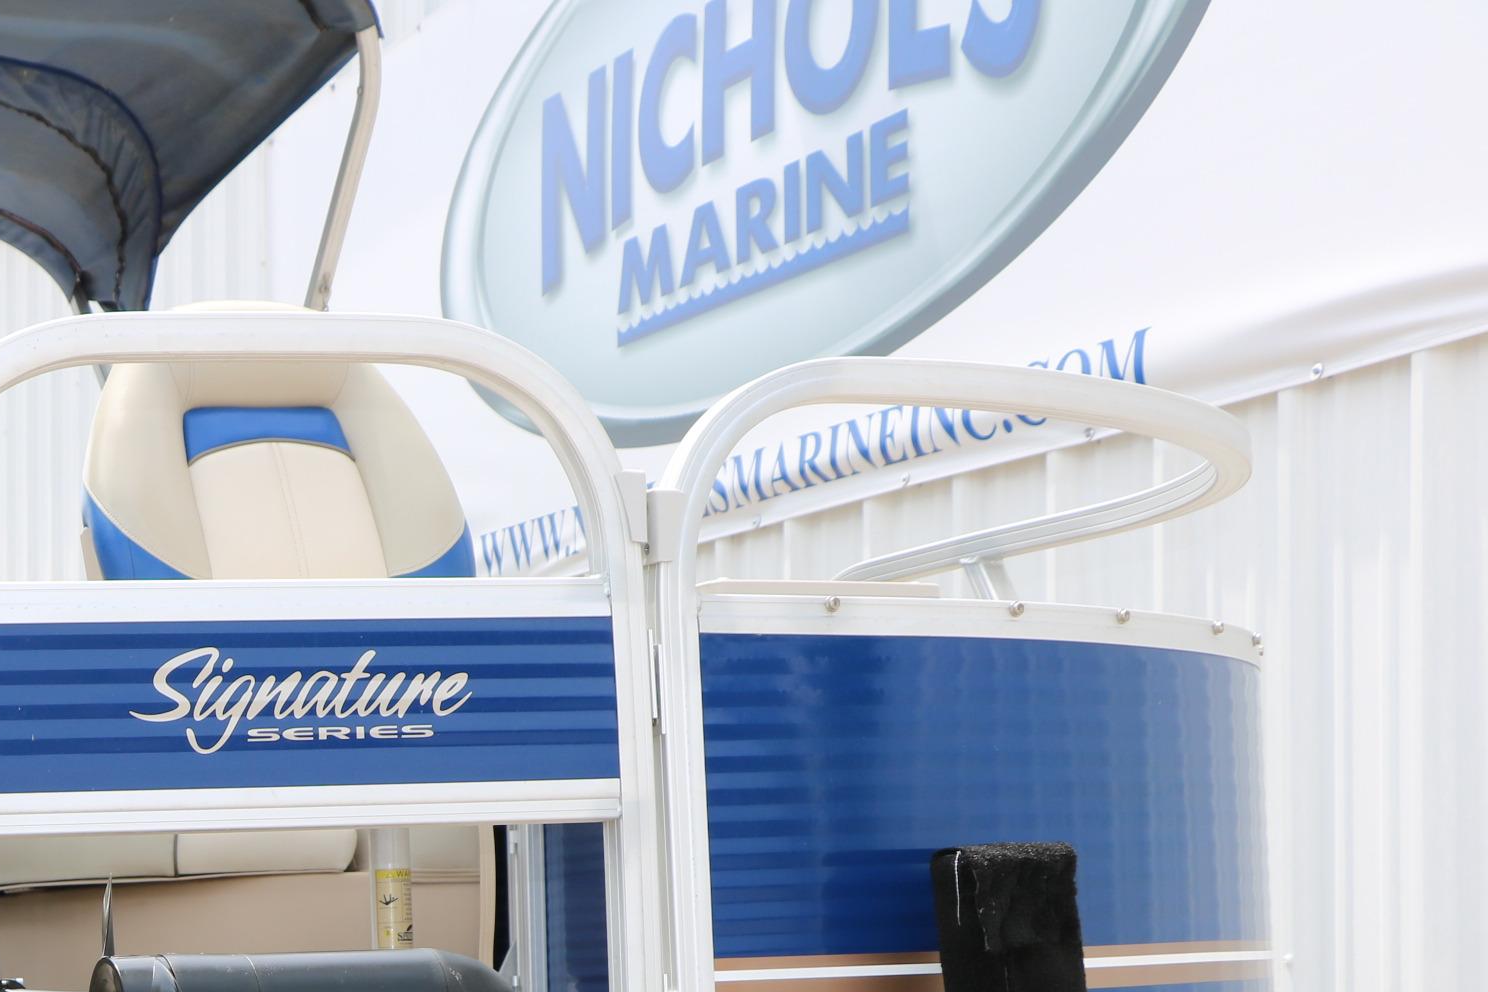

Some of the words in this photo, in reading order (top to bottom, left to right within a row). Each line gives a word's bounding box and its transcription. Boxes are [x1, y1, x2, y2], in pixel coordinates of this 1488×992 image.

[617, 108, 910, 316] MARINE
[128, 646, 473, 755] Signature
[246, 723, 435, 743] SERIES
